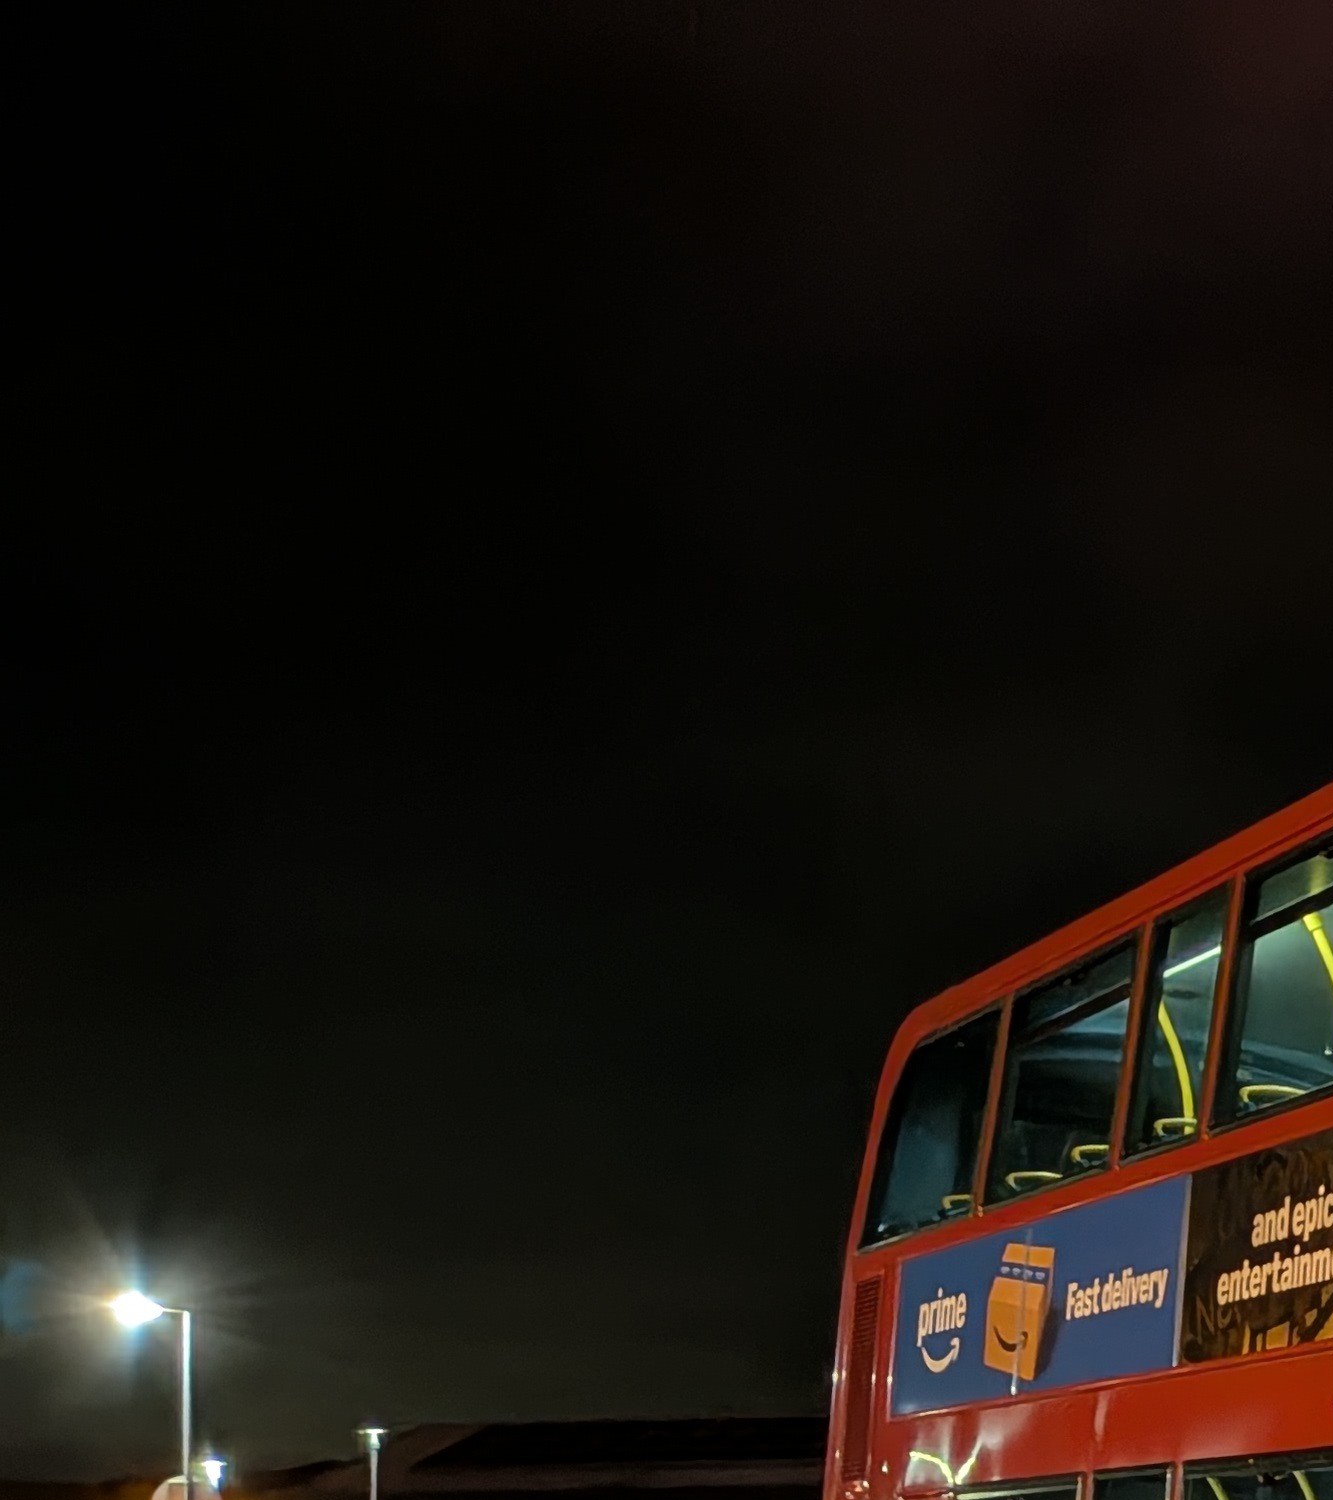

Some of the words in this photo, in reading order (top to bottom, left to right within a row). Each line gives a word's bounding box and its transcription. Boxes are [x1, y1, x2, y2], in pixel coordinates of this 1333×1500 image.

[1251, 1195, 1292, 1247] and
[916, 1287, 967, 1348] prime
[1065, 1277, 1103, 1321] Fast
[1102, 1268, 1170, 1309] delivery
